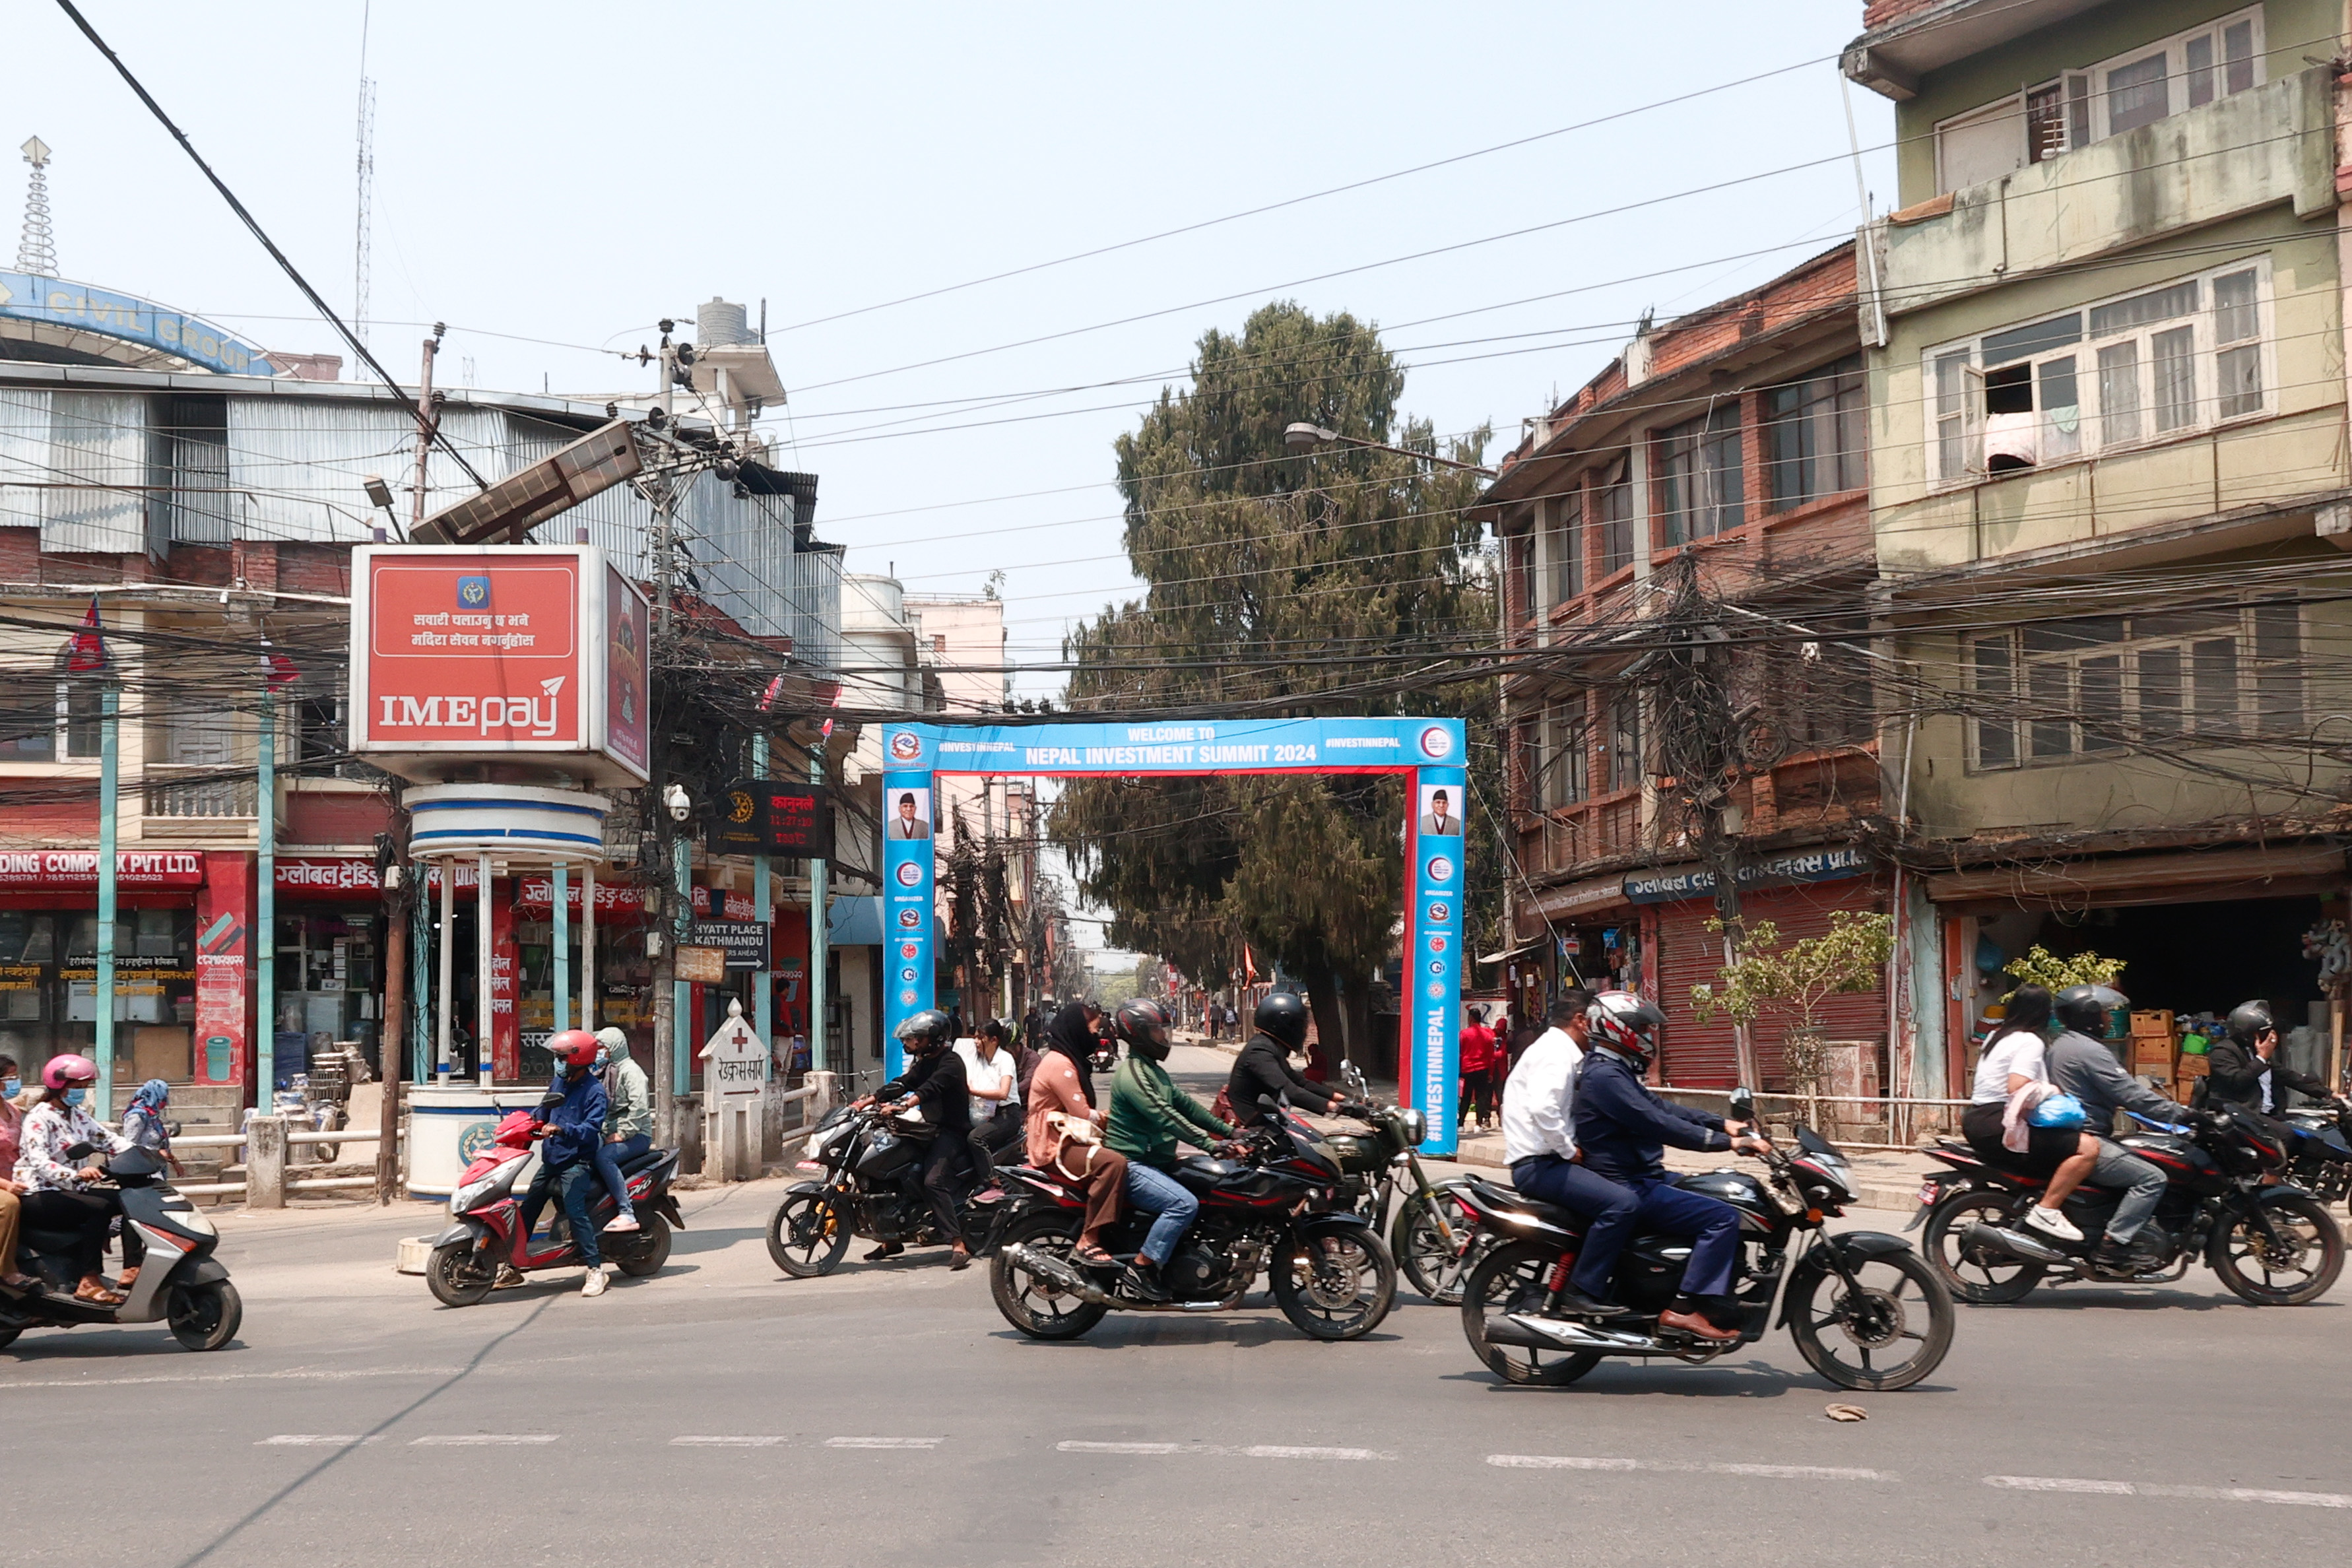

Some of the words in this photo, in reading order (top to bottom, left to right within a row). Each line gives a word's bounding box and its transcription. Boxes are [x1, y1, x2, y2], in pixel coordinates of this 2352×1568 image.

[48, 291, 145, 332] CIVIL
[158, 319, 249, 371] GROUP
[414, 612, 449, 626] सवारी
[451, 614, 493, 630] चलाउनु
[507, 612, 530, 626] भने
[411, 631, 448, 646] मदिरा
[449, 632, 480, 646] सेवन
[1127, 727, 1195, 742] WELCOME
[1197, 727, 1216, 740] TO
[1325, 736, 1401, 748] #INVESTINNEPAL
[938, 741, 1016, 752] #INVESTINNEPAL
[1026, 747, 1082, 765] NEPAL
[1086, 746, 1195, 764] INVESTMENT
[1198, 745, 1270, 763] SUMMIT
[1274, 744, 1317, 762] 2024
[46, 854, 127, 873] COMPX
[130, 856, 164, 873] PVT.
[166, 856, 200, 874] LTD.
[275, 860, 339, 885] ग्लोबल
[525, 880, 582, 902] ग्लोल
[695, 925, 727, 935] HYATT
[731, 925, 764, 935] PLACE
[694, 935, 764, 946] KATHMANDU
[1426, 1006, 1445, 1142] #INVESTINNEPAL
